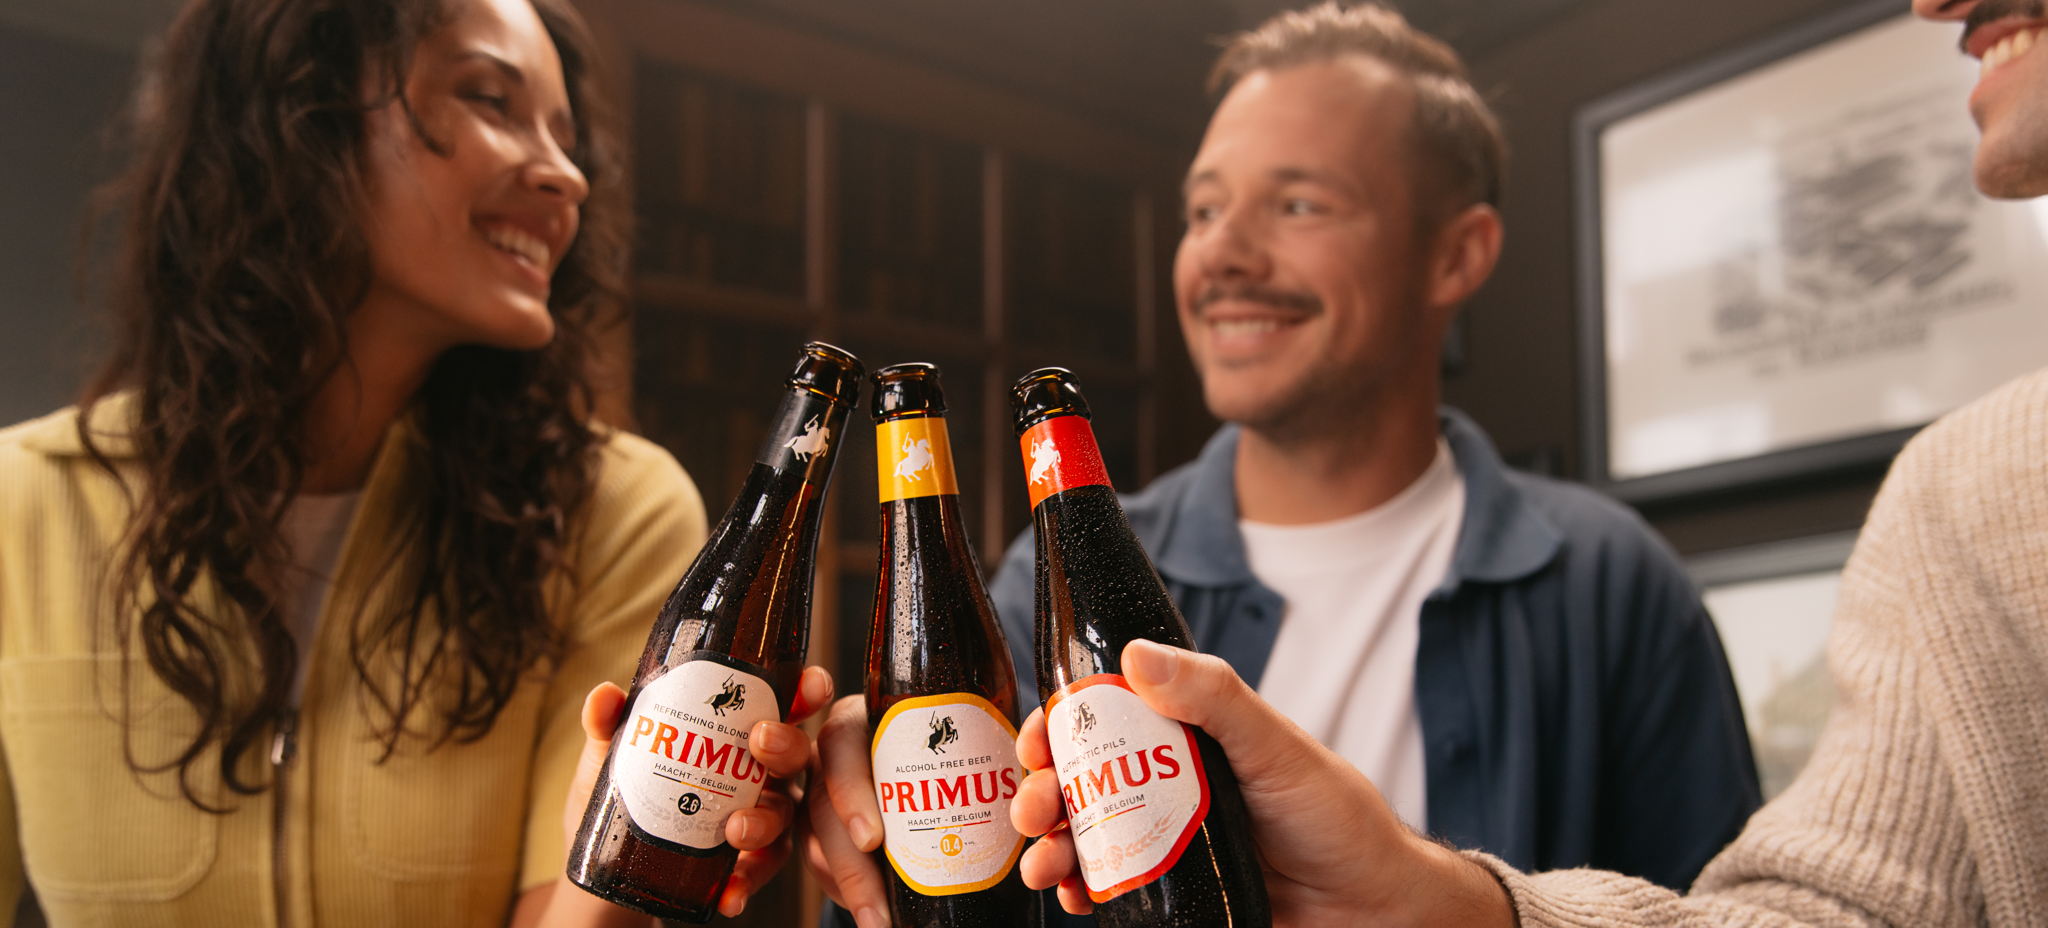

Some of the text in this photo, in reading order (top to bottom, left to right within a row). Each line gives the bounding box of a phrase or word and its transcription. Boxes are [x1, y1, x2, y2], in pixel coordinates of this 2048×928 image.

[654, 703, 749, 740] REFRESHING BLOND
[1103, 737, 1126, 752] PILS
[895, 755, 992, 773] ALCOHOL FREE BEER
[654, 762, 693, 780] HAACHT
[700, 777, 737, 793] BELGIUM
[1063, 745, 1181, 819] RIMUS
[880, 767, 1017, 813] PRIMUS
[680, 795, 699, 812] 2.6
[1103, 793, 1146, 814] BELGIUM
[907, 817, 941, 826] HAACHT
[951, 810, 992, 823] BELGIUM
[942, 837, 961, 852] 0.4
